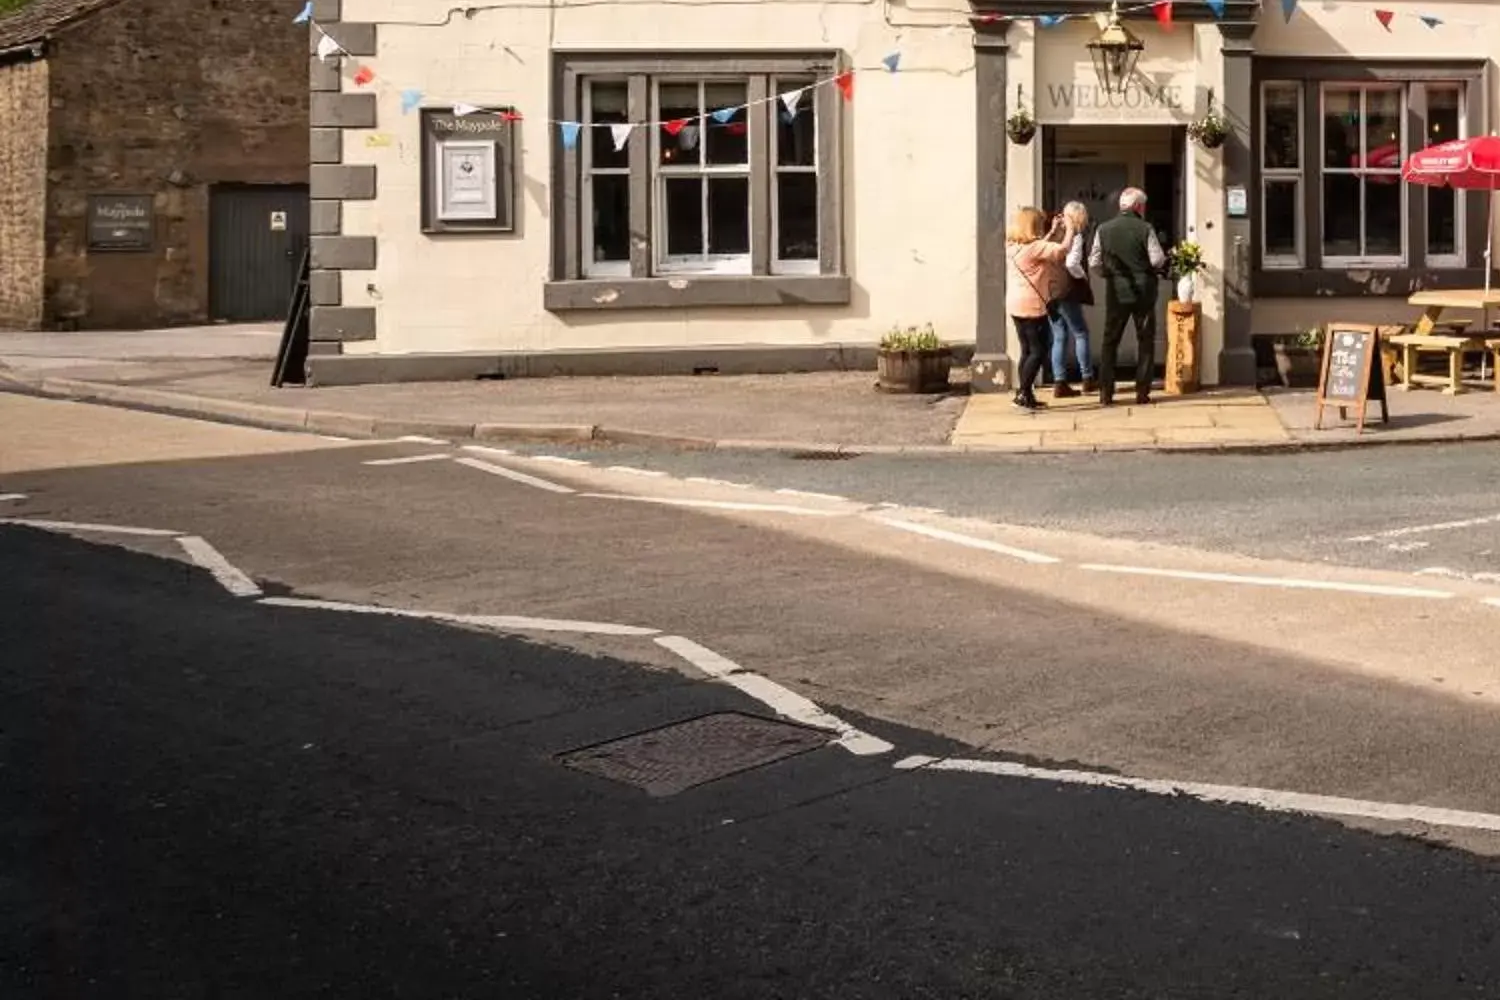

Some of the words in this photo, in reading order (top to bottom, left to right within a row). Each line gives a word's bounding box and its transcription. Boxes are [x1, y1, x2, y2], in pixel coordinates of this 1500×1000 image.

[1047, 83, 1182, 109] WELCOME
[432, 119, 454, 131] The
[455, 119, 504, 133] Maypole
